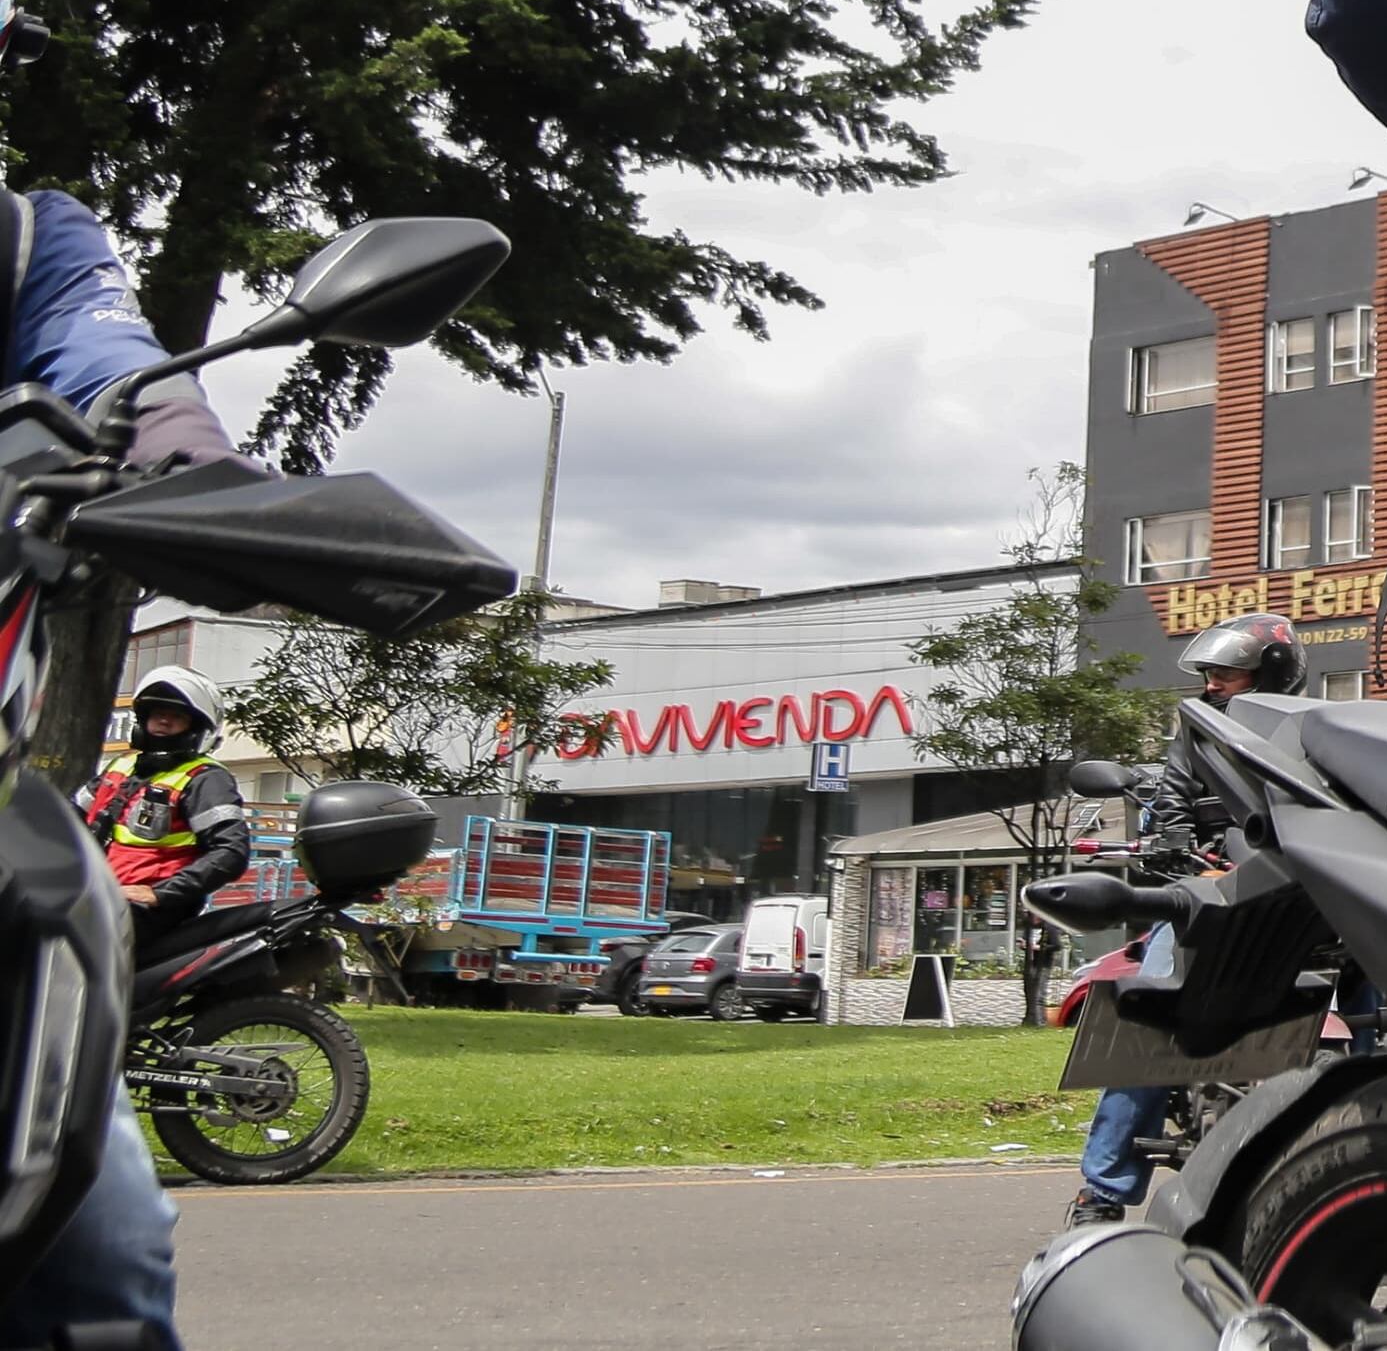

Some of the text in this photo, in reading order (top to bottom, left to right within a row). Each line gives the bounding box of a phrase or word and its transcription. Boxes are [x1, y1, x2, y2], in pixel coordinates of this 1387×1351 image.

[1168, 577, 1268, 633] Hotel
[556, 685, 913, 761] DAVIVIENDA
[818, 781, 847, 790] HOTEL
[126, 1070, 199, 1085] METZELER
